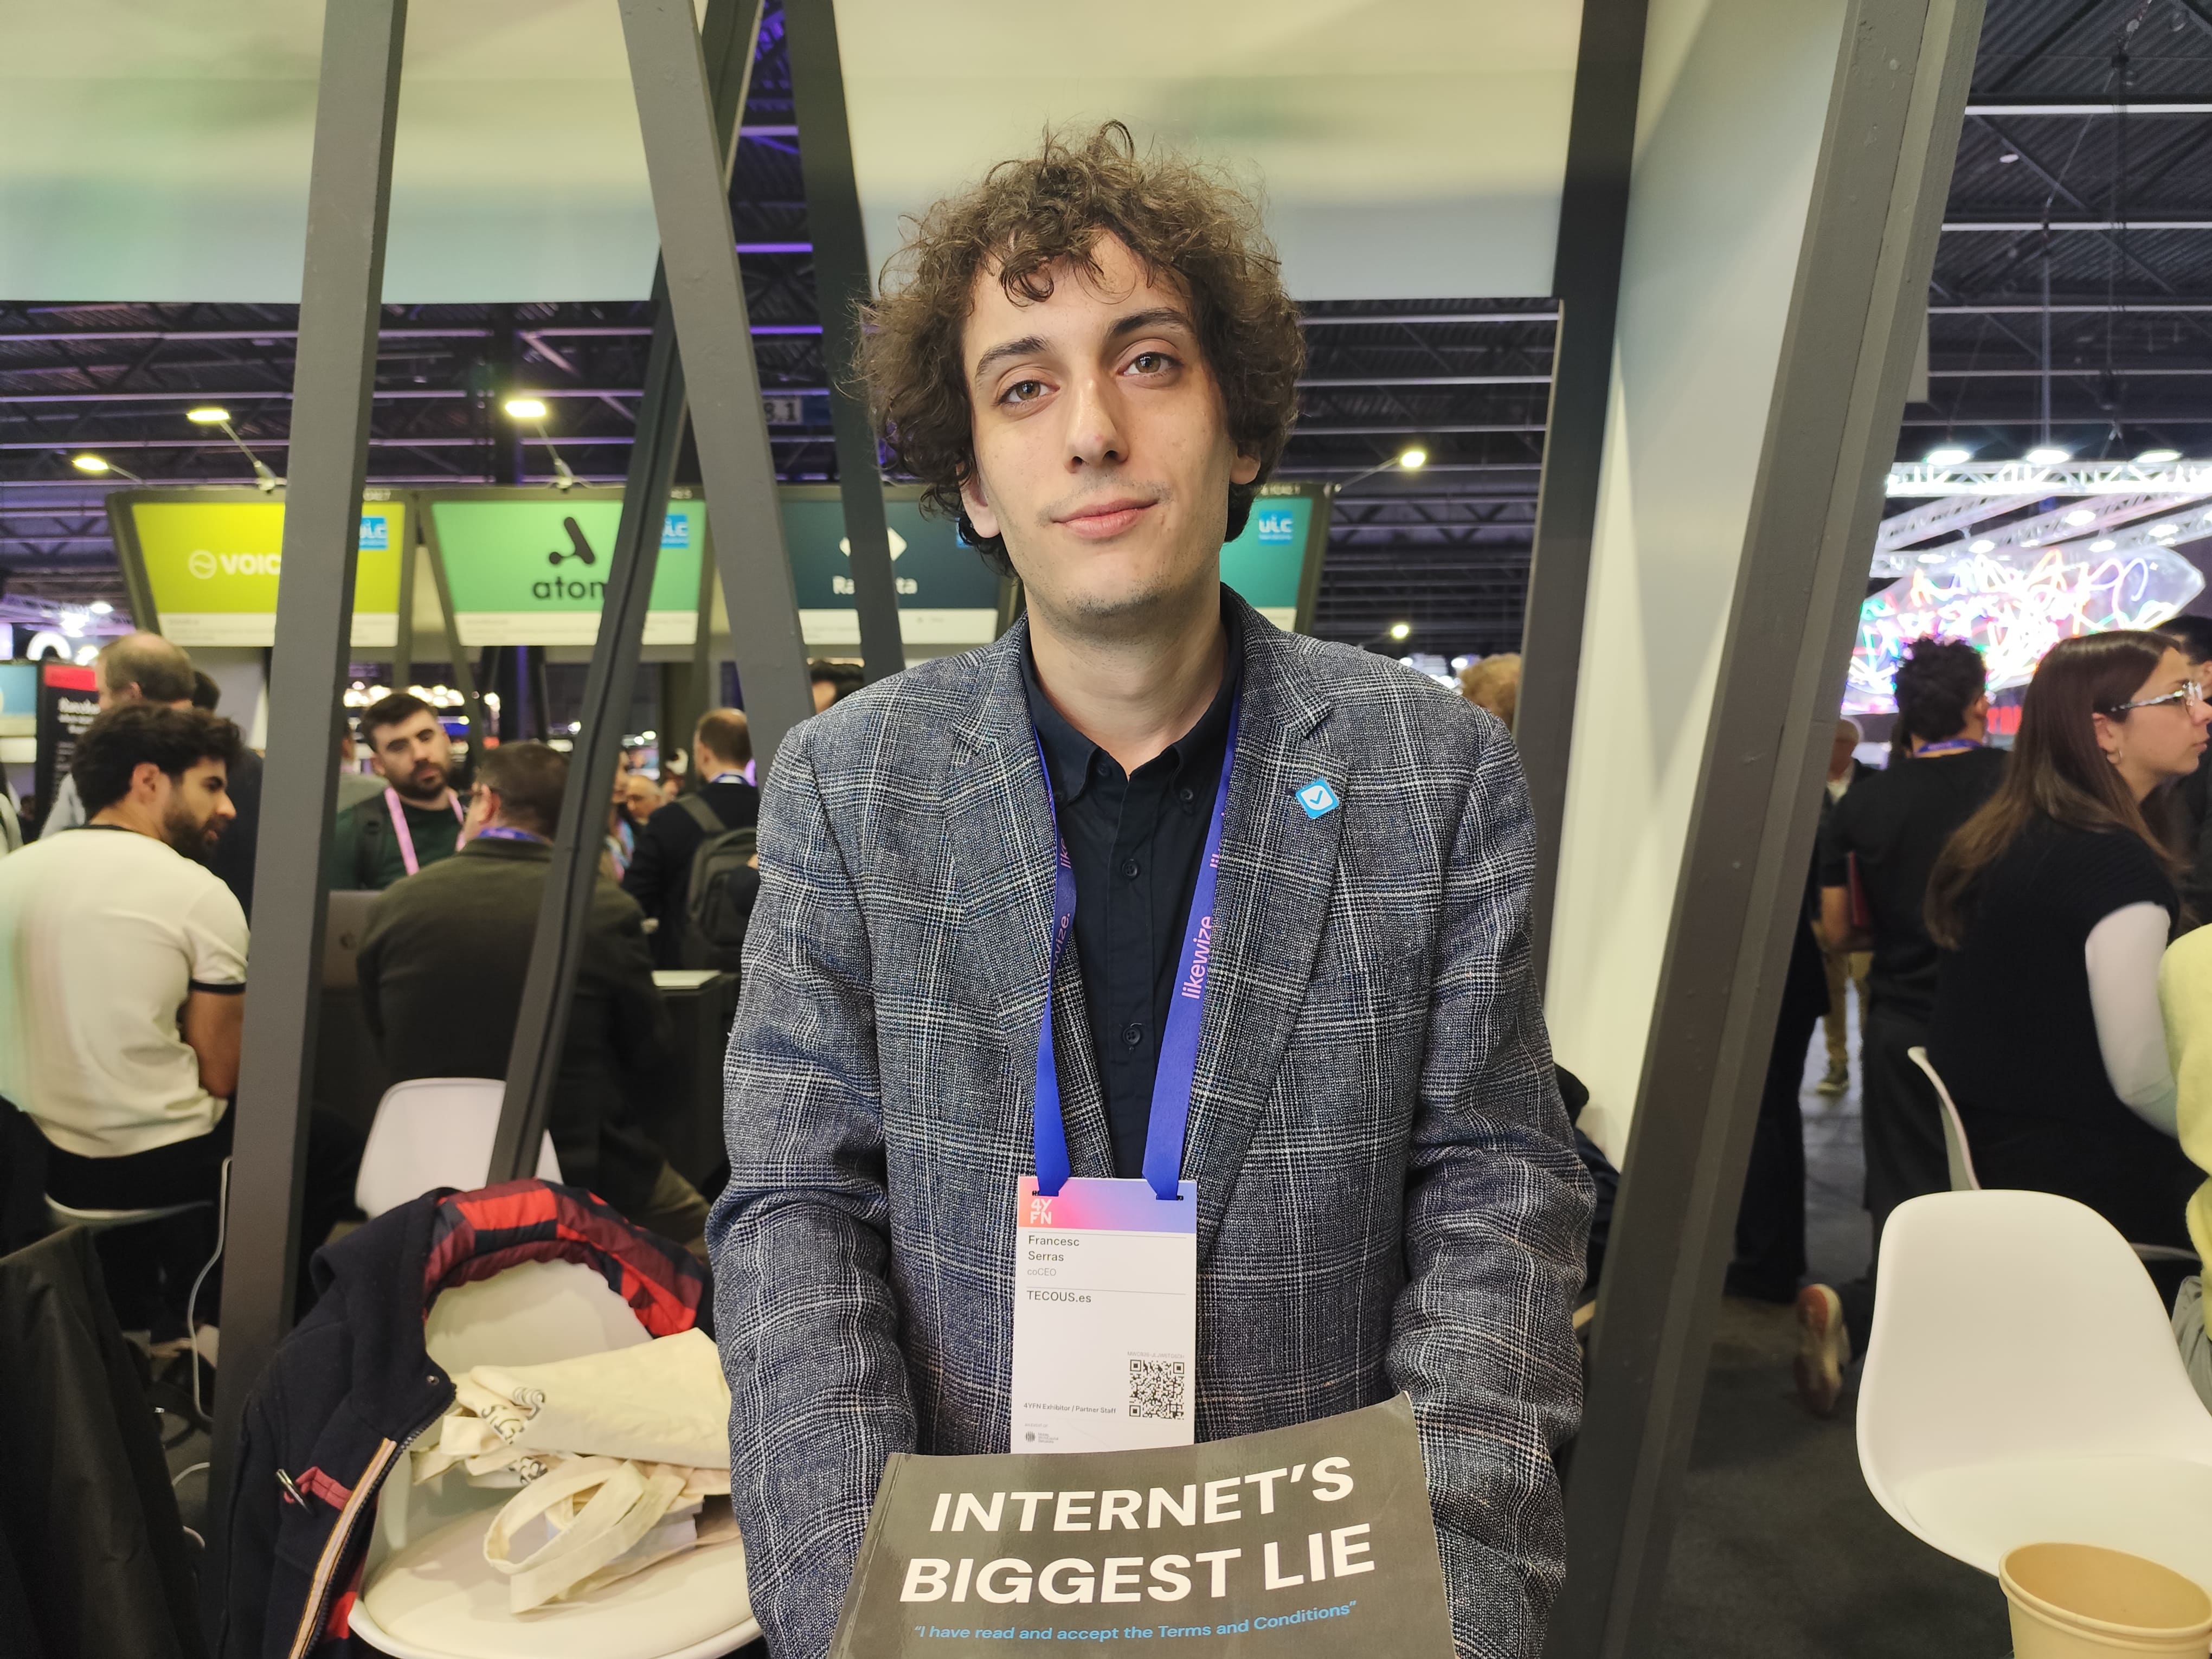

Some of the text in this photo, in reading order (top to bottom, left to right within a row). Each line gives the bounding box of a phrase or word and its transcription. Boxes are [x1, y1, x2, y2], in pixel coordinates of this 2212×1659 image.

[832, 575, 917, 594] Rata
[1030, 1211, 1052, 1224] FN
[1028, 1235, 1080, 1247] Francesc
[1028, 1251, 1064, 1262] Serras
[1027, 1268, 1057, 1276] coCEO
[1027, 1290, 1091, 1303] TECOUS.es
[930, 1457, 1354, 1532] INTERNET’S
[899, 1523, 1375, 1604] BIGGEST LIE
[929, 1626, 970, 1638] have
[975, 1627, 1015, 1639] read
[1019, 1627, 1053, 1640] and
[1057, 1628, 1119, 1642] accept
[1124, 1626, 1153, 1638] the
[1158, 1625, 1212, 1638] Terms
[1216, 1619, 1249, 1635] and
